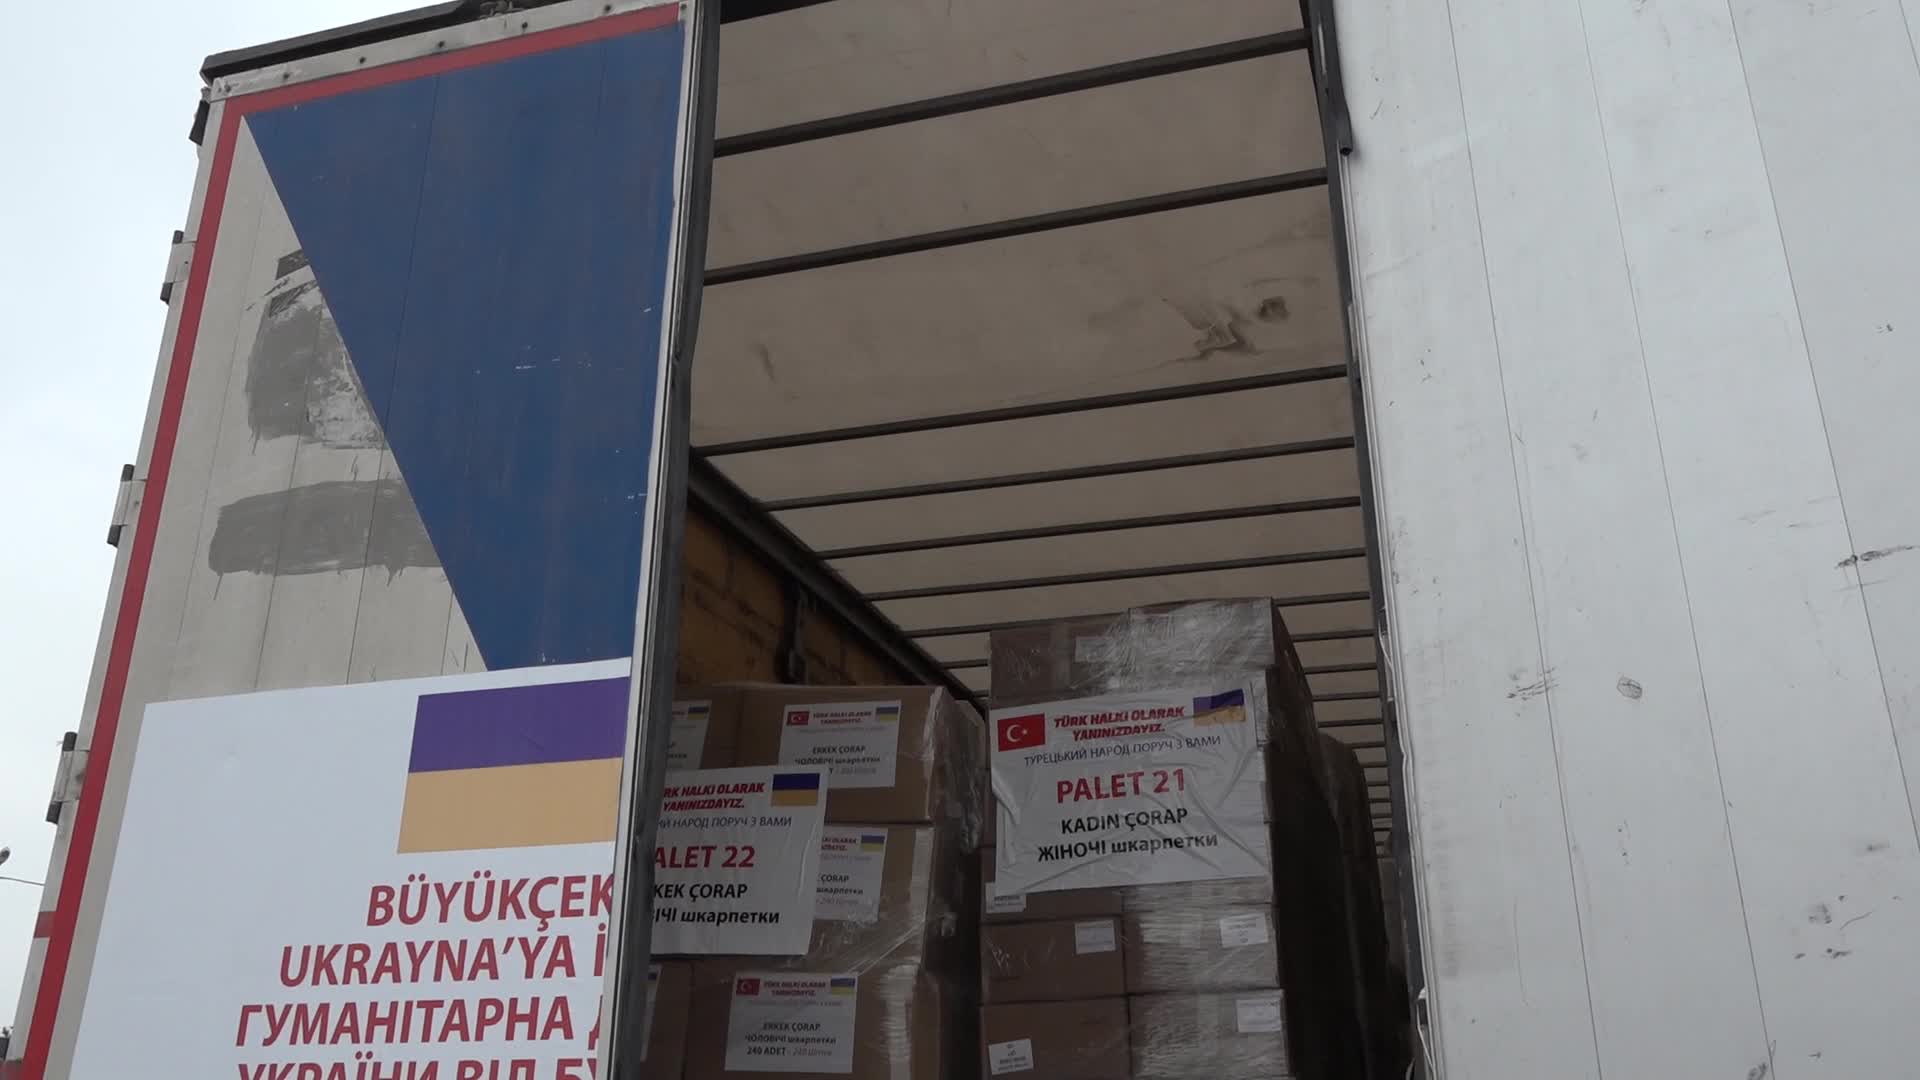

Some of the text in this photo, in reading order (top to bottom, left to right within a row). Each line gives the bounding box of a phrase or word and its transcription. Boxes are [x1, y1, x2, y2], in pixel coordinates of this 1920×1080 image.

[1054, 715, 1089, 729] TÜRK
[1131, 707, 1185, 722] OLARAK
[1024, 750, 1087, 767] ТУРЕЦЬКИЙ
[1090, 744, 1130, 760] НАРОД
[1133, 741, 1171, 755] ПОРУЧ
[1186, 735, 1221, 749] ВАМИ
[682, 784, 715, 797] HALKI
[717, 782, 766, 794] OLARAK
[1056, 768, 1185, 804] PALET 21
[673, 817, 709, 828] НАРОД
[711, 816, 748, 827] ПОРУЧ
[759, 816, 792, 827] ВАМИ
[1061, 808, 1188, 835] KADIN ÇORAP
[721, 845, 756, 868] 22
[1038, 834, 1218, 862] ЖІНОЧІ шкарпетки
[366, 870, 614, 931] BÜYÜKÇEK
[689, 883, 748, 902] ÇORAP
[653, 907, 780, 927] ІЧІ шкарпетки
[279, 935, 576, 987] UKRAYNA'YA
[235, 995, 574, 1047] ГУМАНІТАРНА
